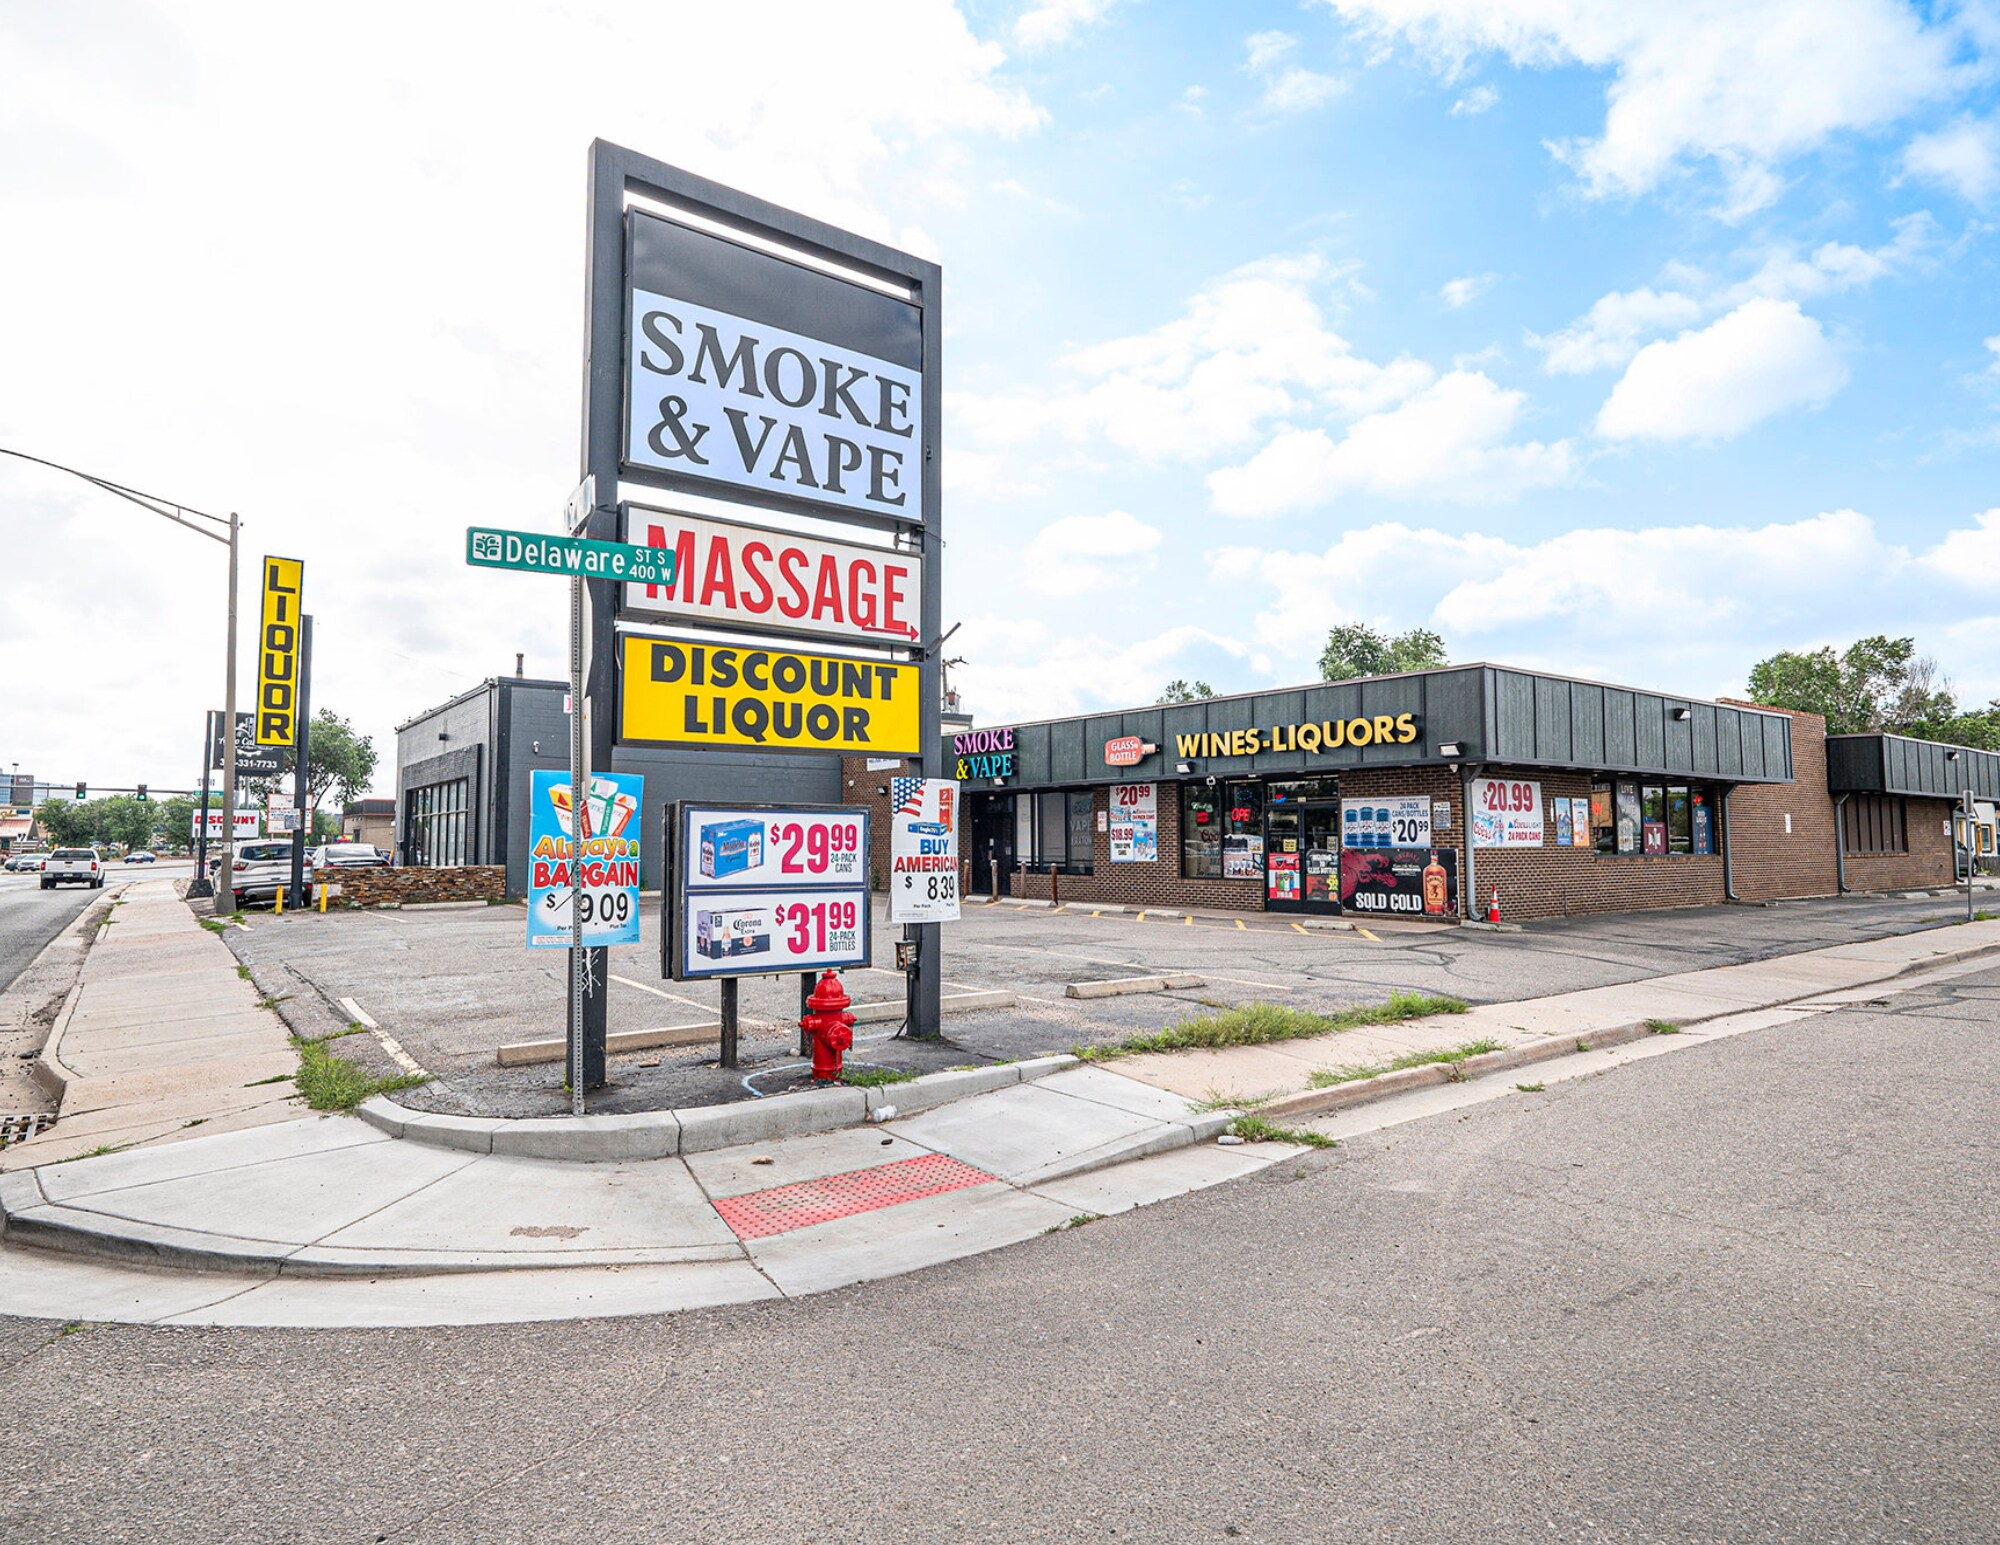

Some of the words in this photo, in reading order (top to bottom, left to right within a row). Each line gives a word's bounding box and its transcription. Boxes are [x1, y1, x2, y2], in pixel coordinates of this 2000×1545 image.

[641, 310, 914, 438] SMOKE
[647, 395, 710, 465] &
[723, 407, 906, 506] VAPE
[506, 535, 626, 575] Delaware
[635, 548, 652, 563] ST
[657, 551, 666, 565] S
[629, 564, 656, 580] 400
[662, 568, 672, 581] W
[646, 524, 909, 632] MASSAGE
[261, 565, 296, 740] LIQUOR
[651, 643, 898, 701] DISCOUNT
[684, 695, 871, 743] LIQUOR
[954, 728, 1014, 755] SMOKE
[1111, 740, 1135, 752] GLASS
[219, 758, 278, 769] 3-331-7733
[1109, 751, 1137, 763] BOTTLE
[955, 758, 968, 780] &
[970, 754, 1013, 778] VAPE
[1482, 781, 1533, 812] $20.99
[1070, 820, 1092, 832] VAPE
[1111, 828, 1133, 841] $18.99
[1508, 831, 1515, 841] 24
[1515, 831, 1528, 841] PACK
[1528, 831, 1541, 841] CANS
[533, 837, 627, 861] Always
[629, 841, 638, 857] a
[920, 839, 949, 854] BUY
[831, 853, 857, 863] 24-PACK
[893, 857, 958, 872] AMERICAN
[835, 863, 853, 873] CANS
[905, 875, 912, 889] $
[546, 894, 556, 909] $
[1356, 892, 1387, 909] SOLD
[1390, 894, 1422, 910] COLD
[829, 931, 856, 941] 24-PACK
[830, 941, 856, 952] BOTTLES
